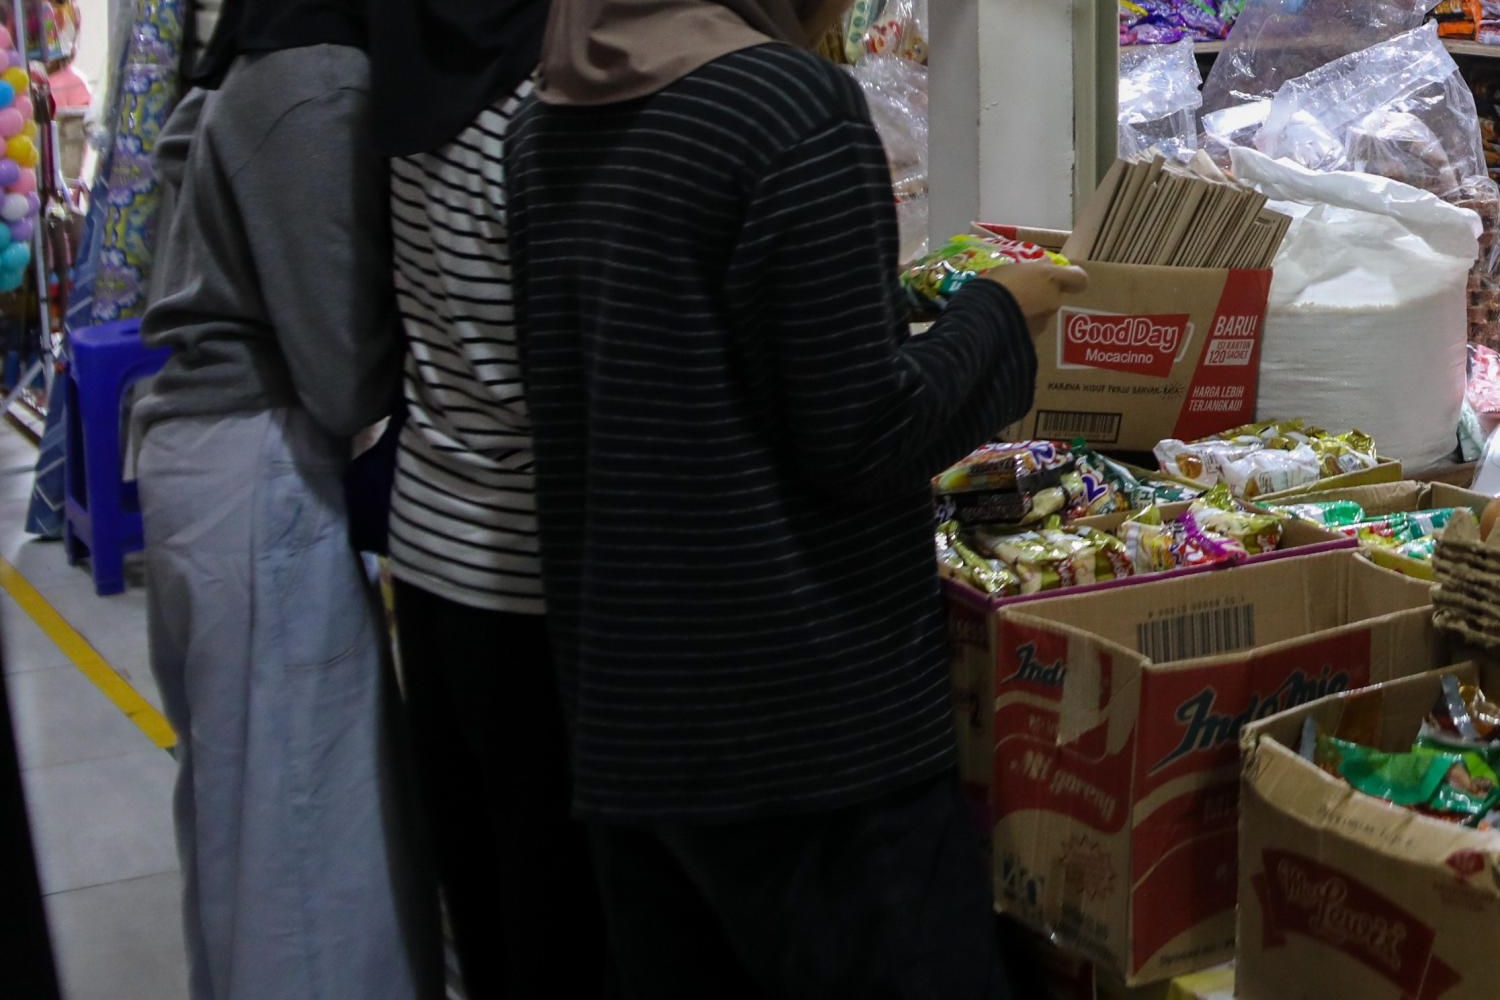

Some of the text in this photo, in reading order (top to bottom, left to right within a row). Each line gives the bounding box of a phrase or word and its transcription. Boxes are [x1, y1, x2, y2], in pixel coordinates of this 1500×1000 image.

[1214, 315, 1258, 338] BARU!
[1086, 348, 1154, 365] Mocacinno
[1209, 350, 1225, 364] 120
[1192, 386, 1245, 398] HARGA LEBIH
